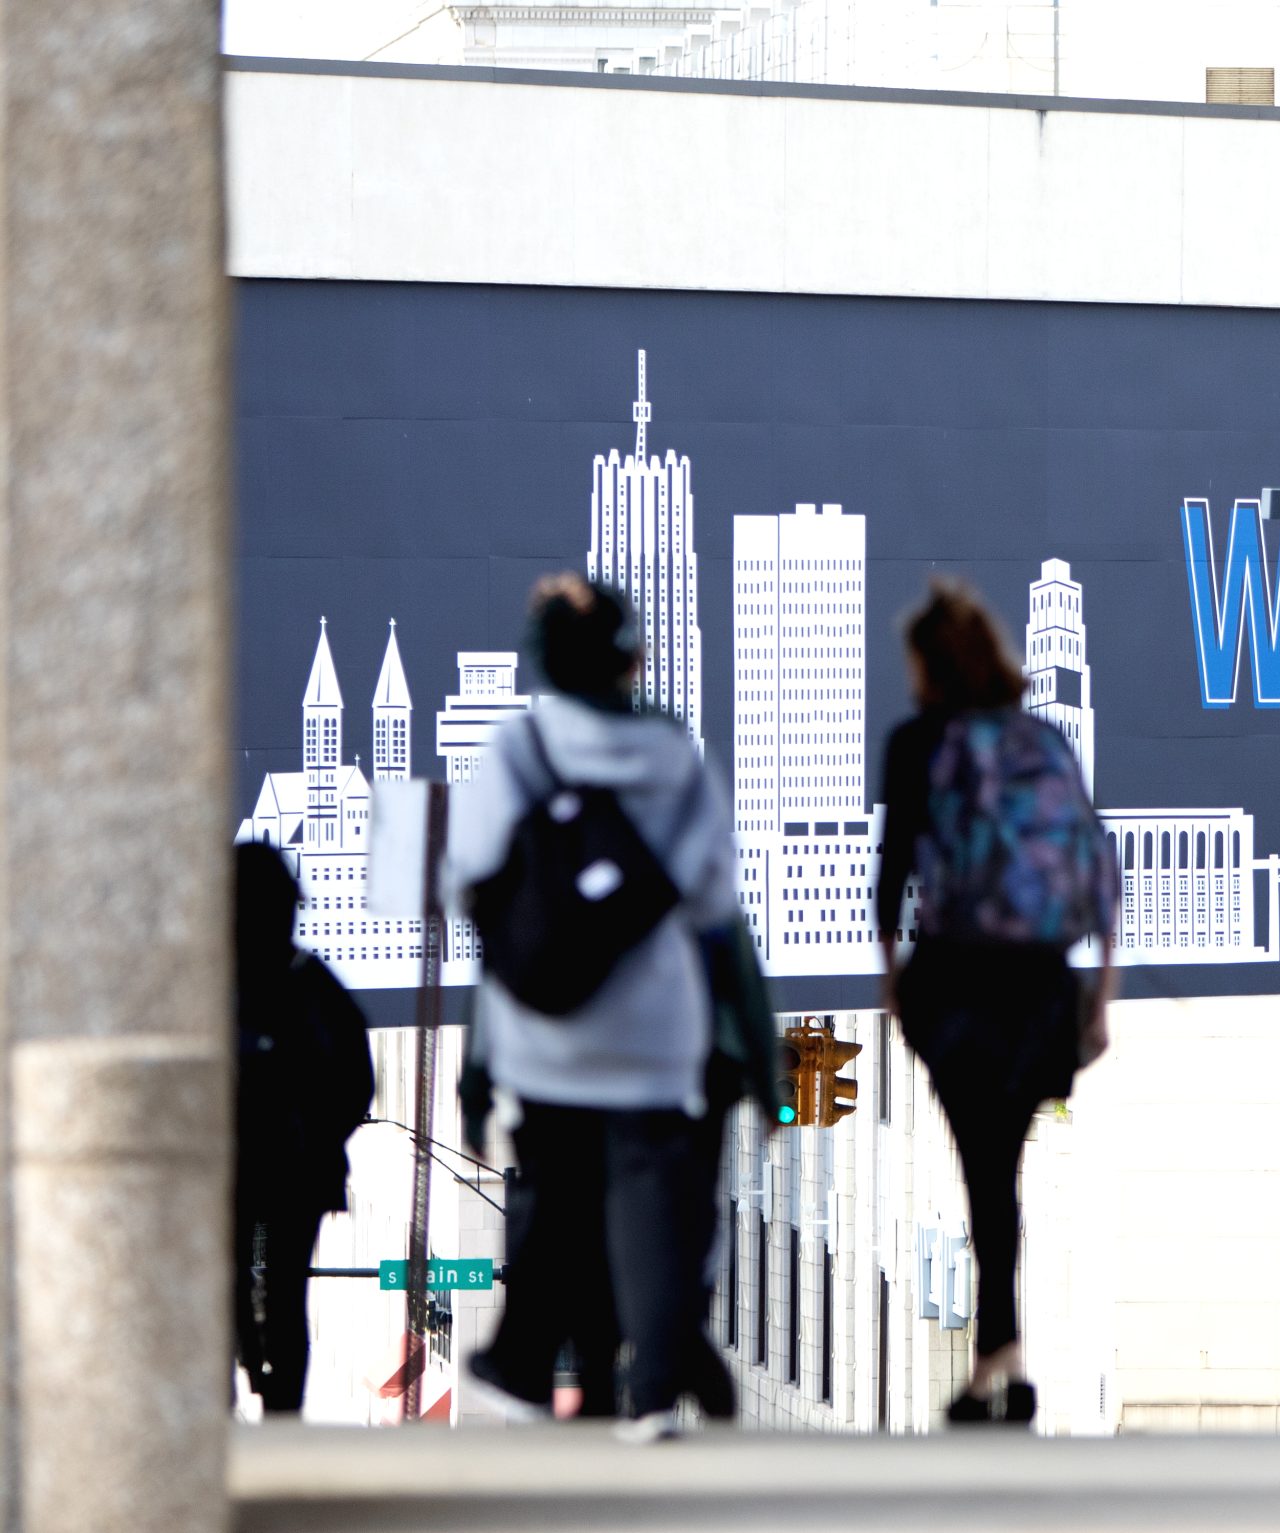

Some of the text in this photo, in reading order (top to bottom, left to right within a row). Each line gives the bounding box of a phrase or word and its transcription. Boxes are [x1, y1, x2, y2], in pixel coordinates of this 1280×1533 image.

[388, 1266, 484, 1284] S ain St
